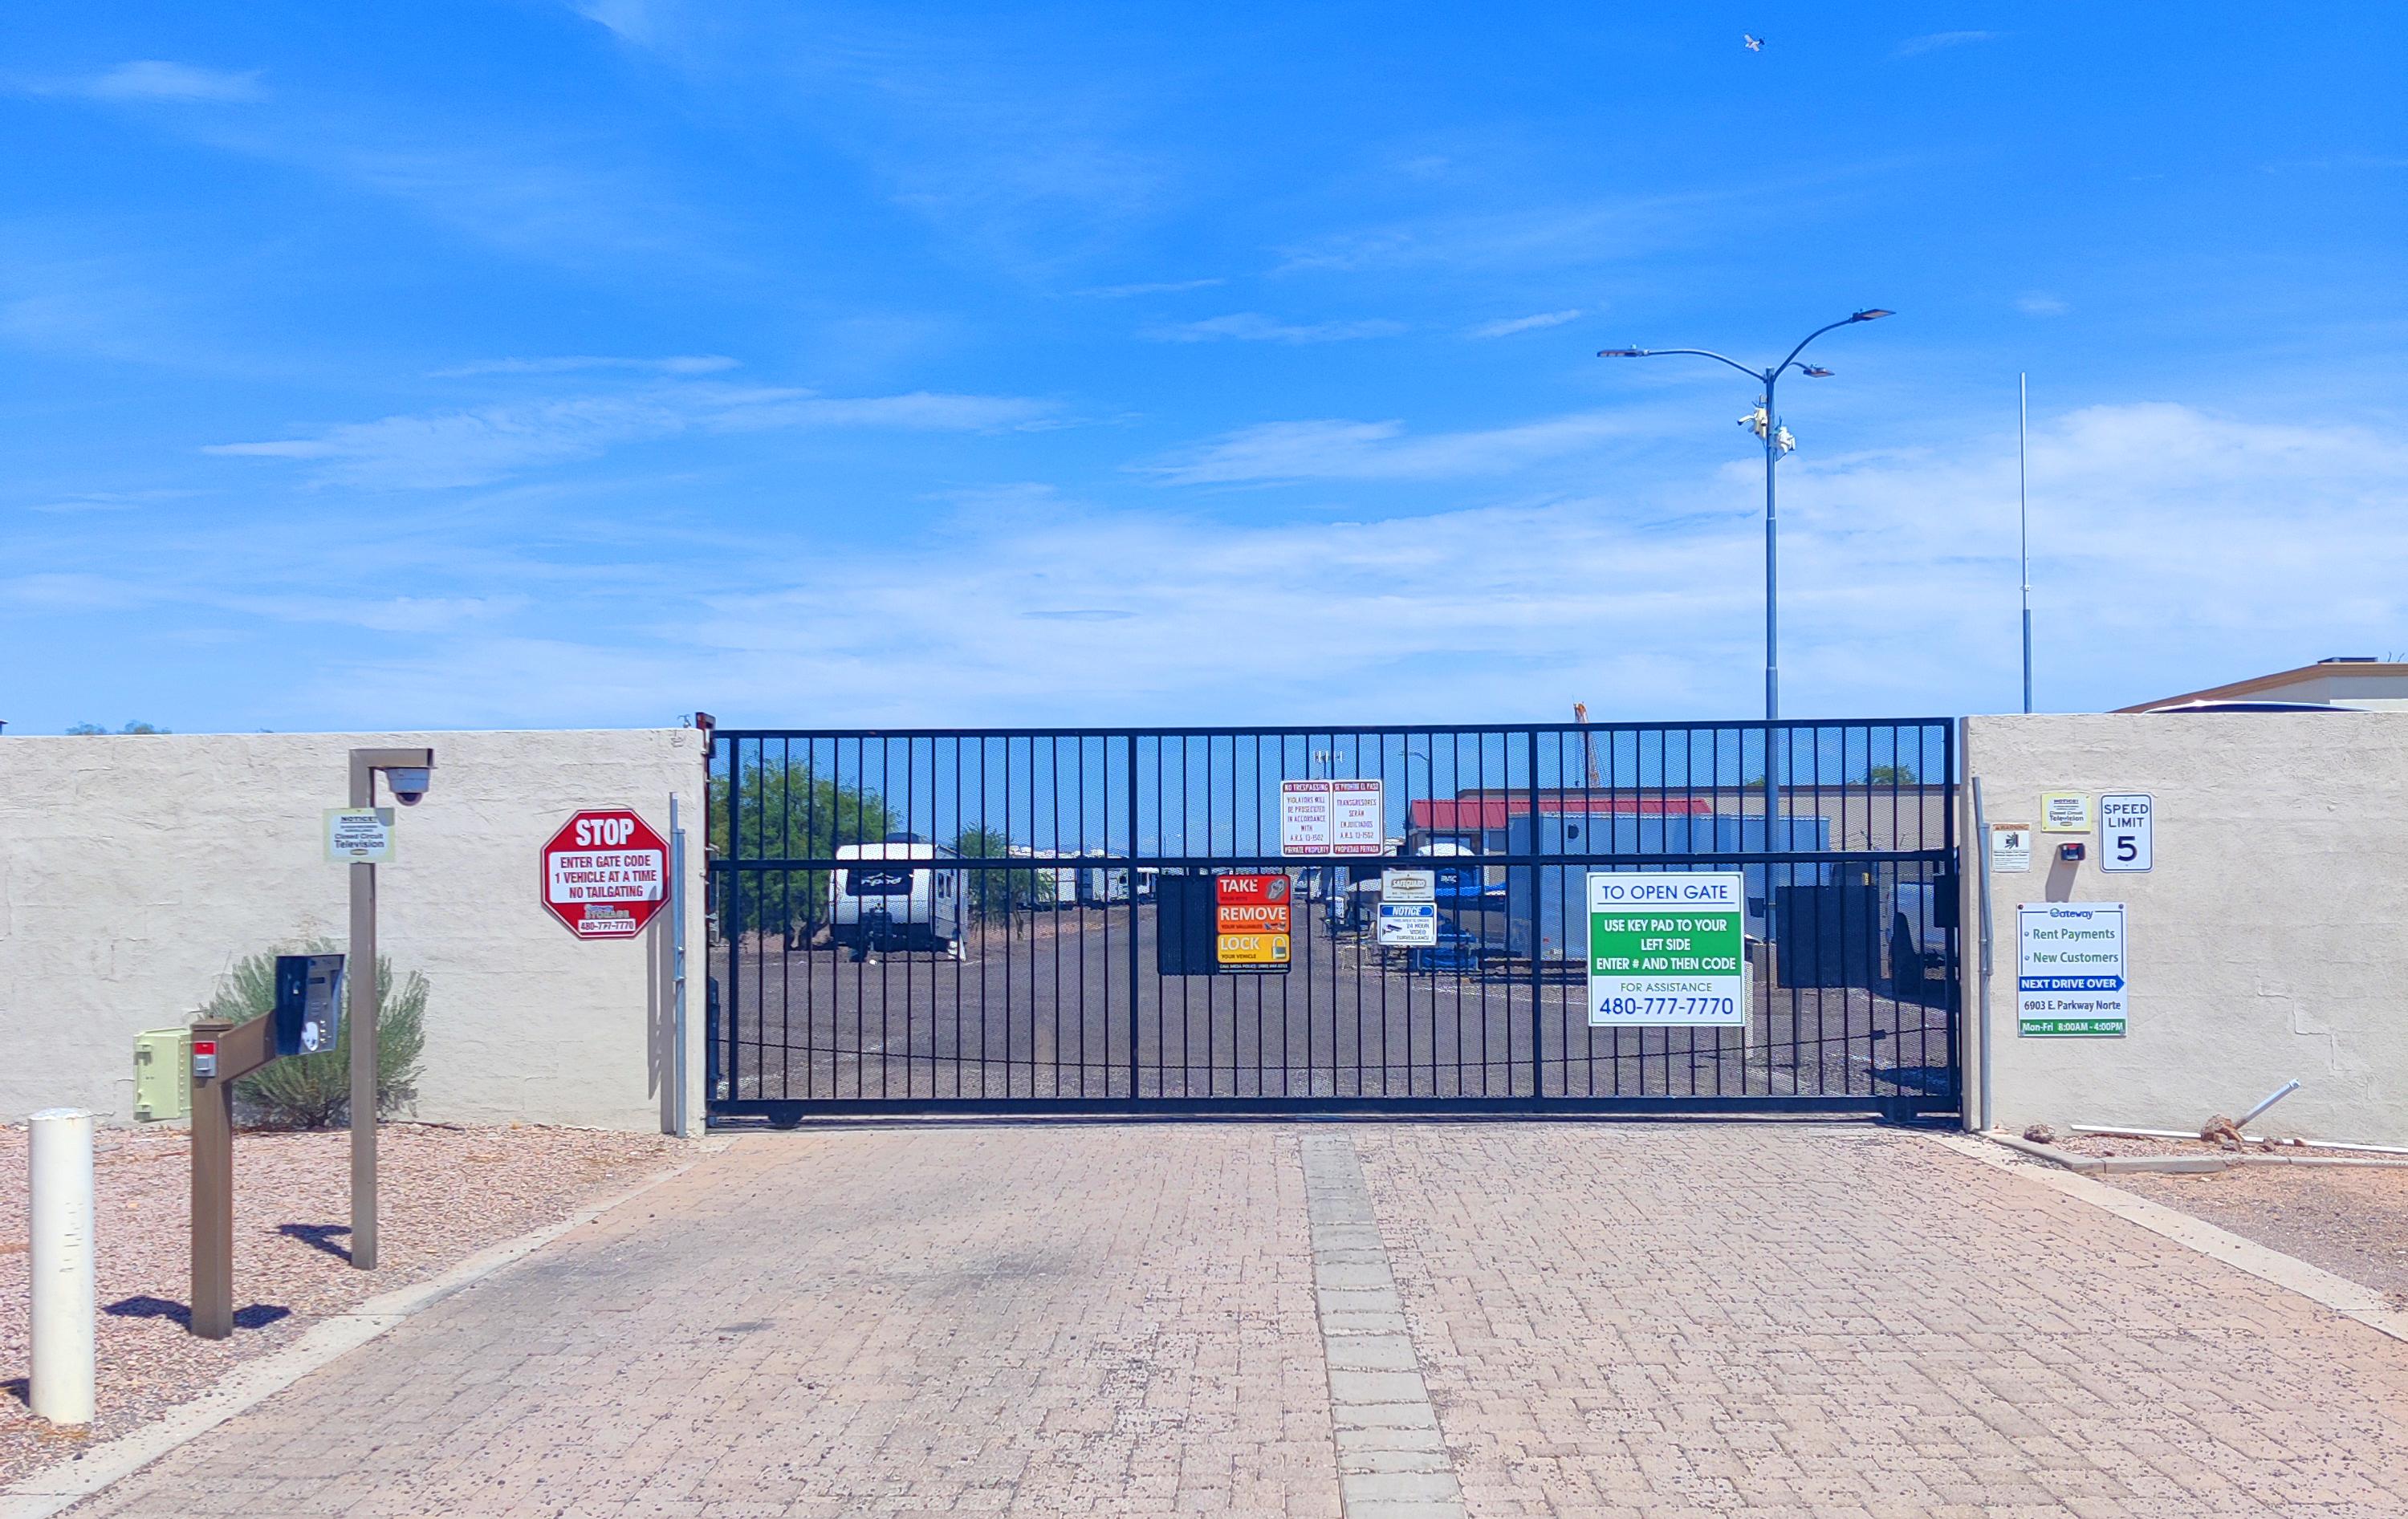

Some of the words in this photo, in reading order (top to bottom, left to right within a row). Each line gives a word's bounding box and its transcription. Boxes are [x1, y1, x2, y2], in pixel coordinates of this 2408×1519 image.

[1294, 783, 1328, 791] TRESPASSING
[2105, 804, 2148, 814] SPEED
[2109, 817, 2144, 828] LIMIT
[576, 818, 634, 846] STOP
[334, 839, 384, 848] Television
[2117, 836, 2137, 862] 5
[560, 856, 592, 868] ENTER
[596, 855, 621, 867] GATE
[624, 855, 650, 867] CODE
[555, 873, 560, 883] 1
[563, 871, 605, 883] VEHICLE
[608, 871, 620, 883] AT
[623, 870, 630, 882] A
[633, 870, 657, 881] TIME
[1220, 879, 1258, 892] TAKE
[570, 887, 583, 899] NO
[586, 886, 642, 898] TAILGATING
[1602, 886, 1625, 899] TO
[1631, 886, 1678, 899] OPEN
[1684, 886, 1727, 899] GATE
[1220, 907, 1286, 920] REMOVE
[1393, 906, 1421, 916] NOTICE
[2050, 908, 2093, 920] Gateway
[1604, 920, 1625, 931] USE
[1628, 920, 1648, 931] KEY
[1651, 920, 1674, 931] PAD
[1676, 920, 1692, 931] TO
[1694, 920, 1727, 931] YOUR
[2033, 929, 2058, 939] Rent
[2061, 928, 2115, 942] Payments
[1221, 937, 1260, 950] LOCK
[1641, 939, 1663, 951] LEFT
[1666, 939, 1690, 951] SIDE
[1597, 958, 1629, 969] ENTER
[1633, 959, 1639, 968] #
[1642, 958, 1668, 969] AND
[1670, 958, 1698, 969] THEN
[1702, 957, 1735, 969] CODE
[2034, 952, 2057, 963] New
[2060, 952, 2119, 963] Customers
[1621, 982, 1642, 992] FOR
[1645, 982, 1712, 992] ASSISTANCE
[2021, 979, 2050, 989] NEXT
[2052, 979, 2084, 989] DRIVE
[2087, 979, 2117, 989] OVER
[1600, 997, 1734, 1014] 480-777-7770
[2024, 1001, 2045, 1010] 6903
[2048, 1001, 2055, 1009] E.
[2058, 1000, 2094, 1012] Parkway
[2097, 1000, 2121, 1009] Norte
[2023, 1022, 2053, 1032] Mon-Fri
[2058, 1022, 2089, 1031] 8:00AM
[2094, 1022, 2123, 1030] 4:00PM
